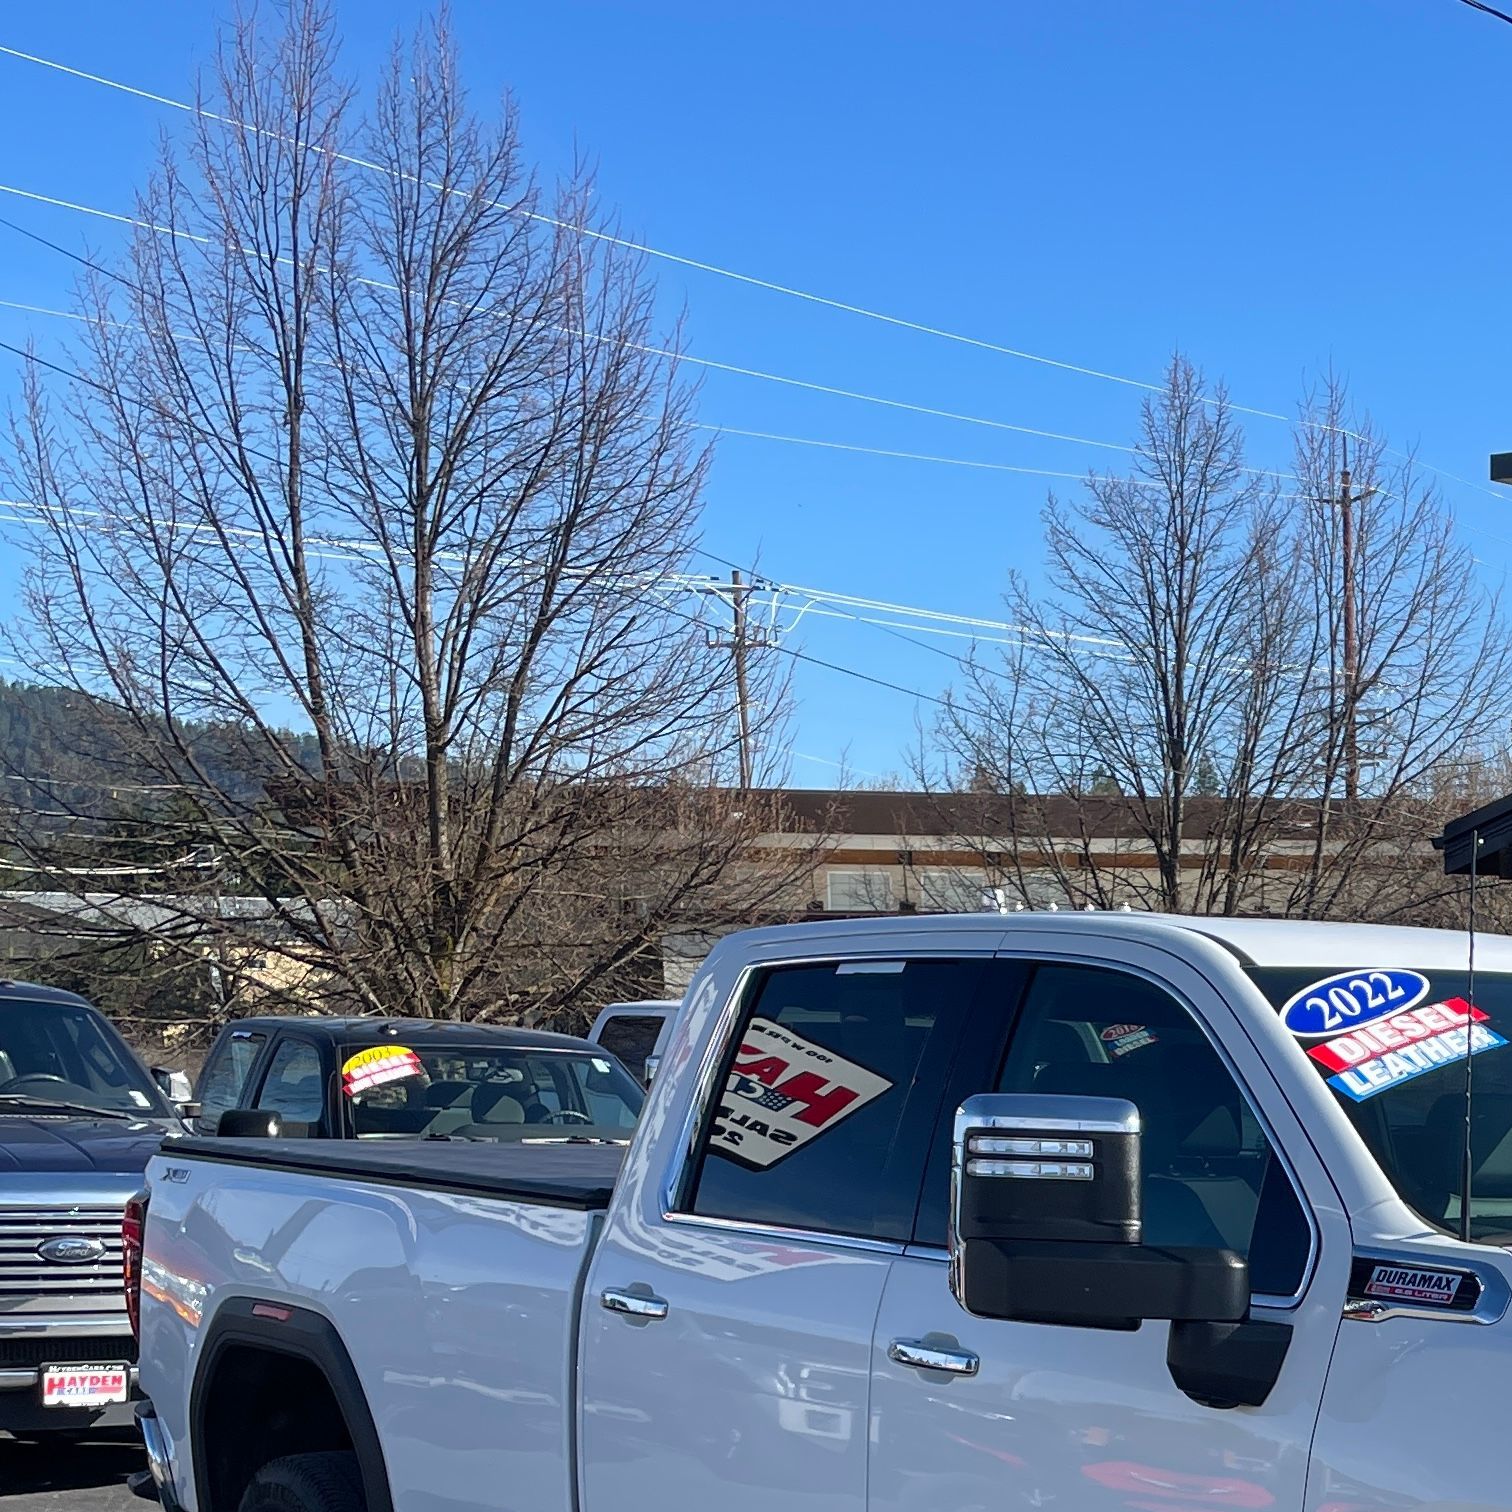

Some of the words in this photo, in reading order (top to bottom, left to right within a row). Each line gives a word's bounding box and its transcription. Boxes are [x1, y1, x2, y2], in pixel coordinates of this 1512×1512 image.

[1305, 972, 1406, 1030] 2022
[1325, 1002, 1475, 1065] DIESEL
[1338, 1023, 1500, 1096] LEATHER
[1375, 1268, 1457, 1292] DURAMAX
[46, 1375, 123, 1395] HAYDEN
